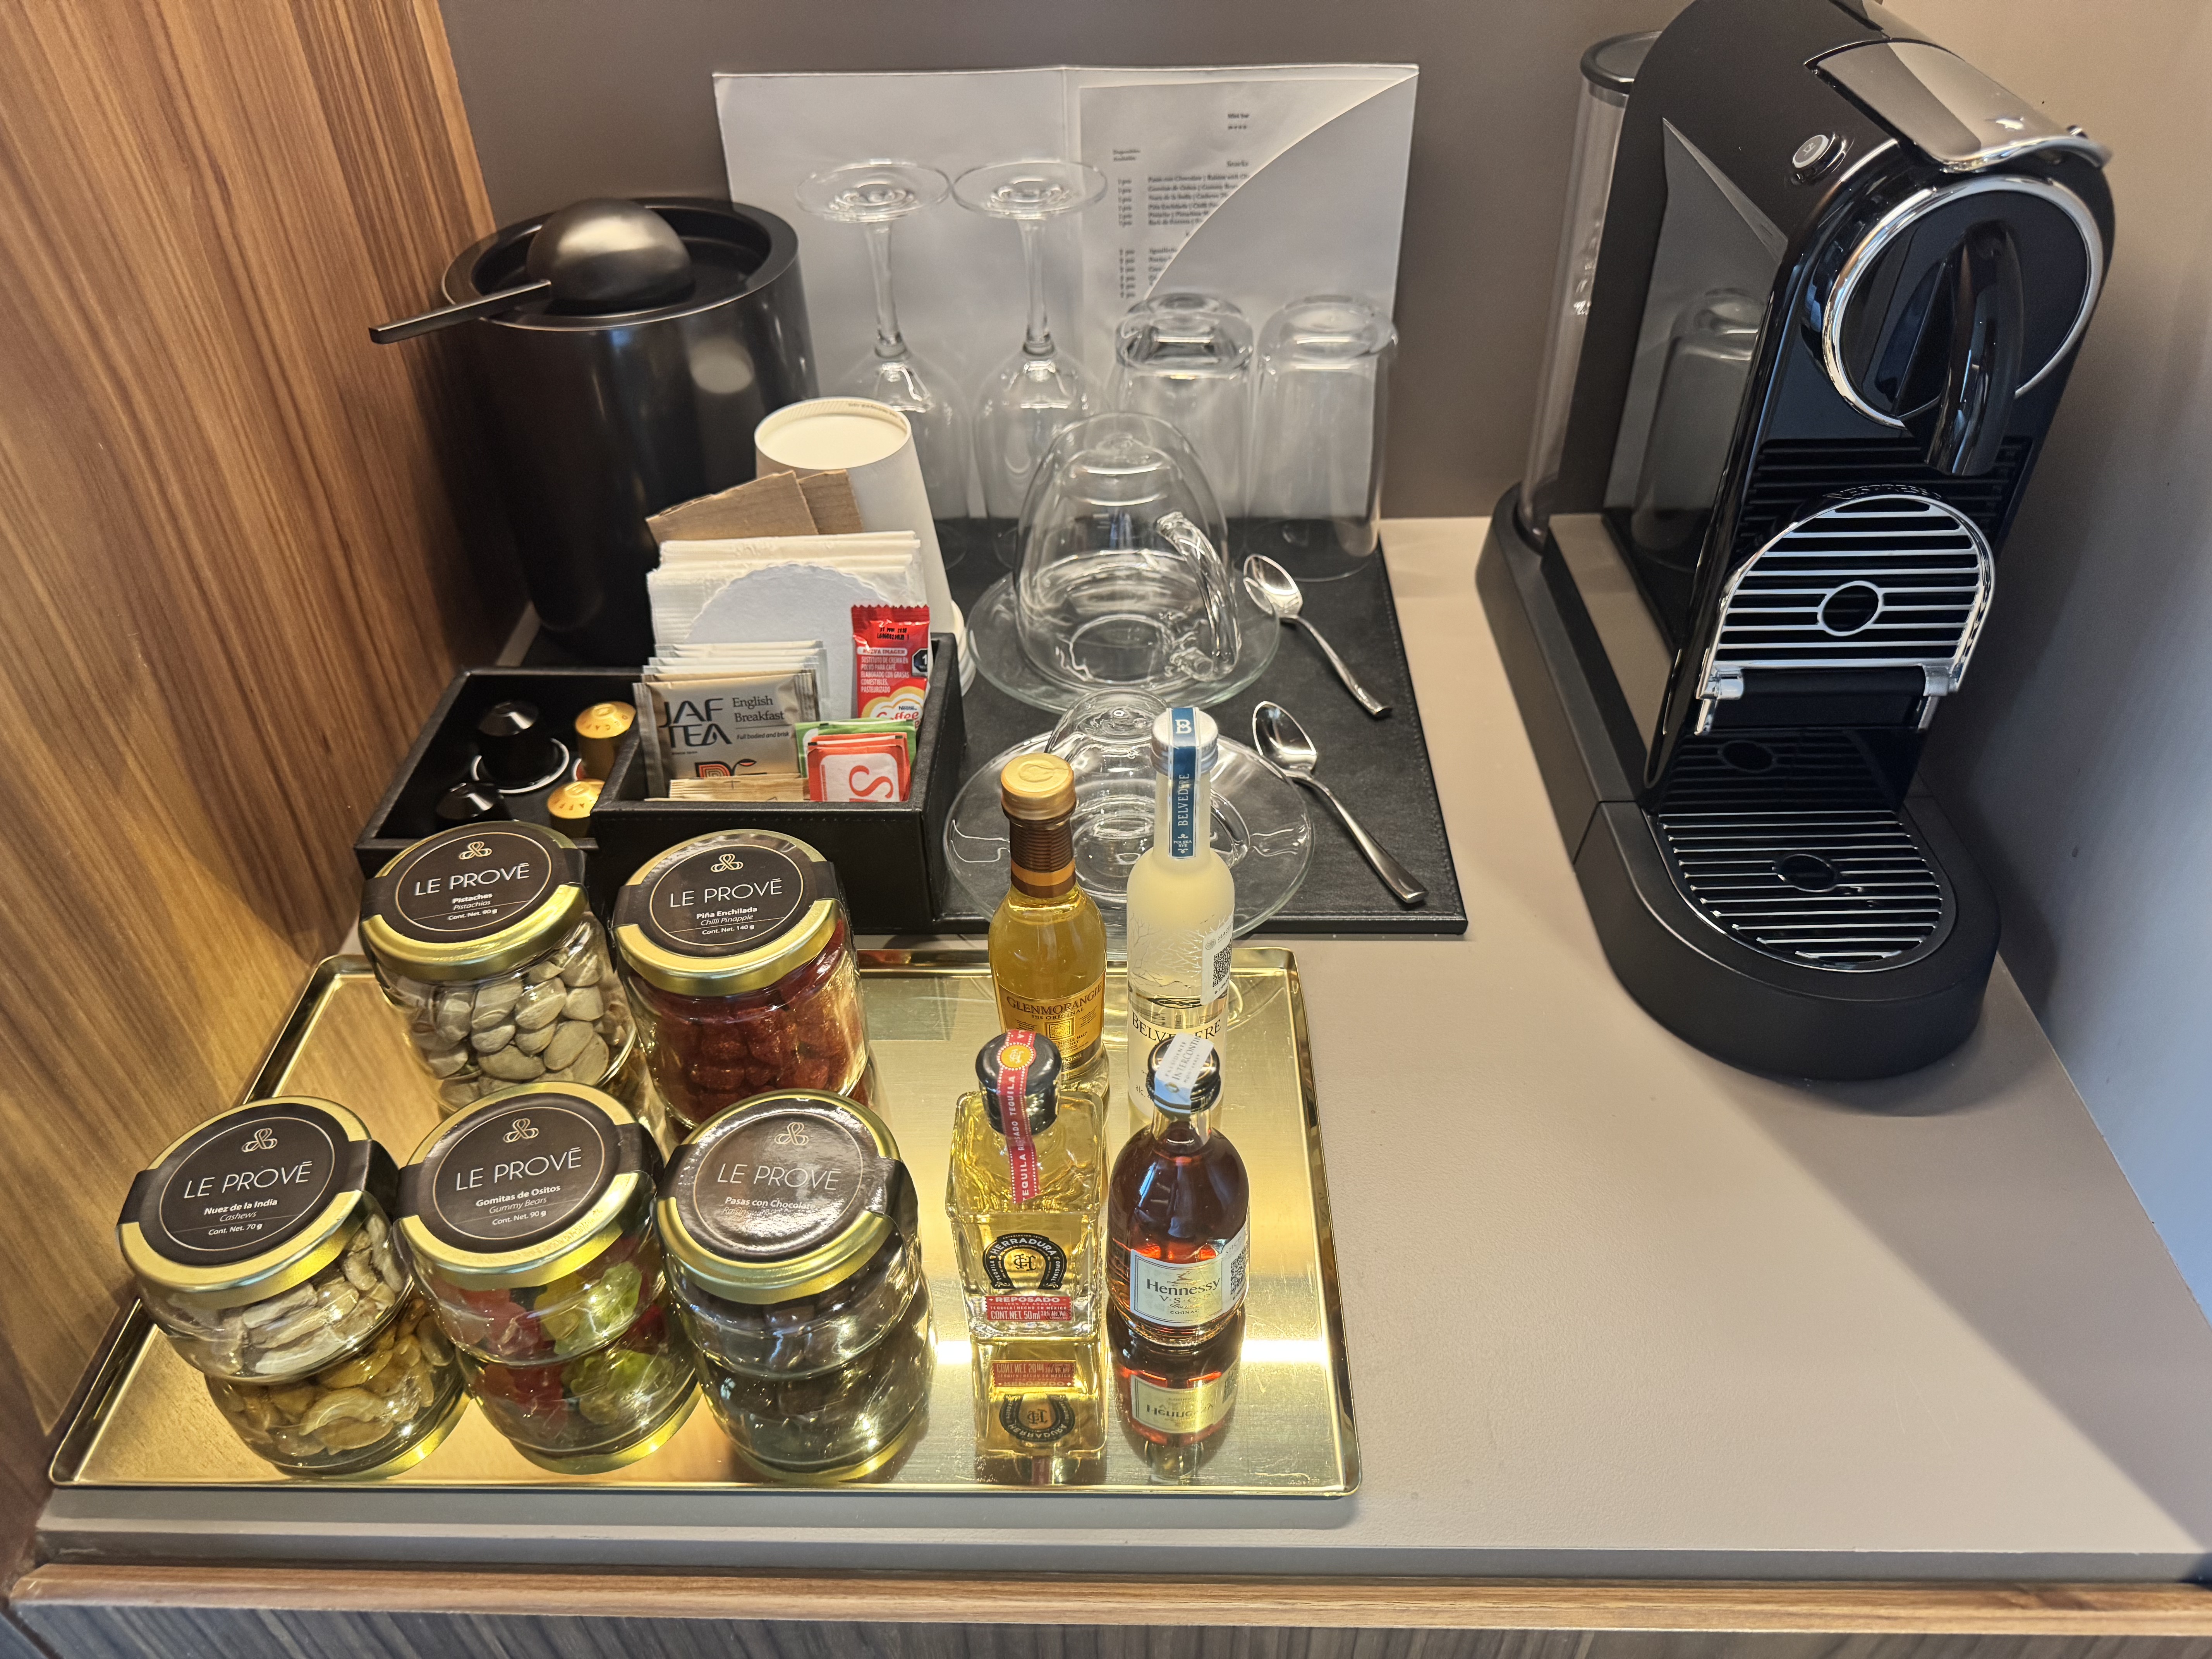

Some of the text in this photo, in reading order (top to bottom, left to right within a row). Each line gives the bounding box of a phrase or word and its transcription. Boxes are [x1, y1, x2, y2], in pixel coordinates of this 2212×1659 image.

[733, 696, 773, 709] English
[658, 698, 723, 728] JAF
[734, 711, 785, 723] Breakfast
[668, 723, 733, 748] TEA
[414, 878, 441, 896] LE
[452, 893, 493, 904] Pistaches
[453, 900, 491, 911] Pistachios
[670, 890, 694, 908] LE
[701, 914, 754, 926] Chilli Pinapple
[717, 907, 758, 917] Enchilada
[1007, 982, 1103, 1015] GLENMORANGIE
[1007, 1075, 1016, 1116] TEQUILA
[456, 1168, 484, 1191] LE
[717, 1163, 748, 1183] LE
[184, 1177, 215, 1199] LE
[476, 1194, 515, 1207] Gomitas
[531, 1185, 561, 1196] Ositos
[204, 1206, 229, 1215] Nuez
[230, 1203, 242, 1211] de
[254, 1199, 278, 1208] India
[489, 1197, 547, 1214] Gummy Bears
[725, 1197, 750, 1205] Pasas
[770, 1199, 816, 1210] Chocolate
[220, 1211, 258, 1222] Cashews
[990, 1237, 1057, 1256] HERRADURA
[989, 1260, 1002, 1281] TEQUILA
[1051, 1261, 1061, 1281] ORIGINAL
[1147, 1278, 1220, 1295] Hennessy
